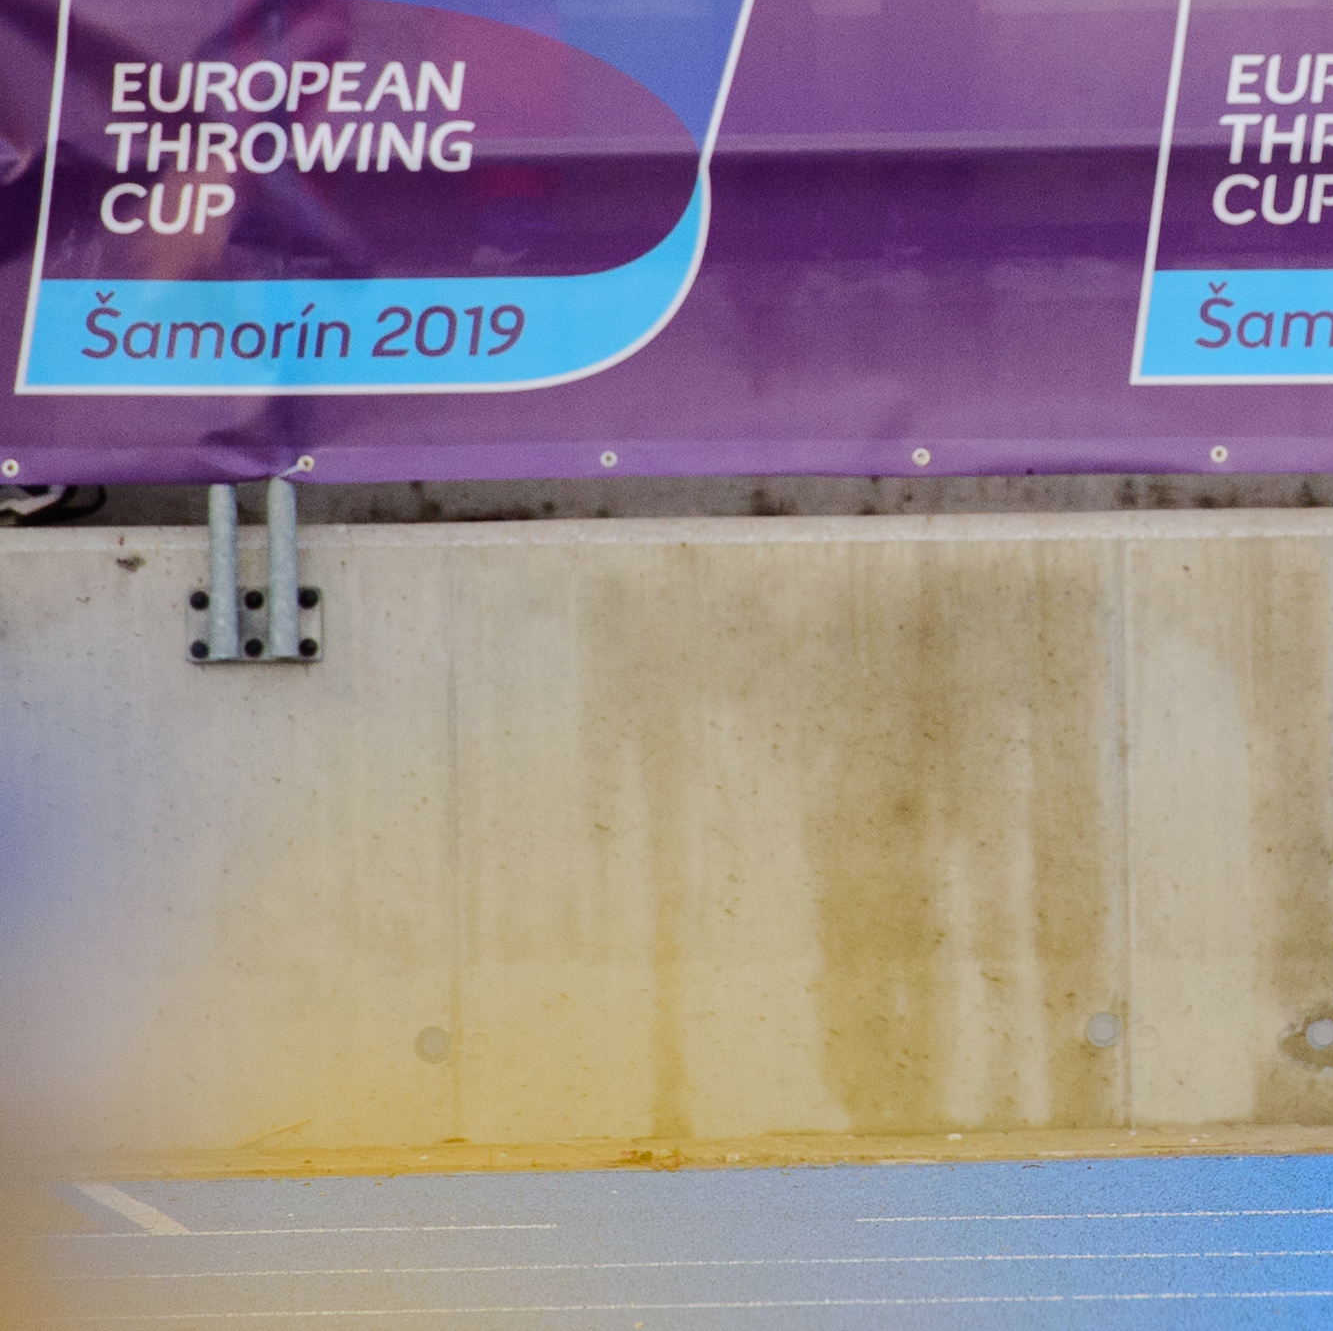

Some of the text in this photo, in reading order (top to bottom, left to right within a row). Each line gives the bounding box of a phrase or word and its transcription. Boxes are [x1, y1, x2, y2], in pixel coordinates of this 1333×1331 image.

[110, 60, 467, 114] EUROPEAN
[104, 120, 477, 172] THROWING
[100, 183, 236, 235] CUP
[81, 291, 526, 360] Šamorín 2019
